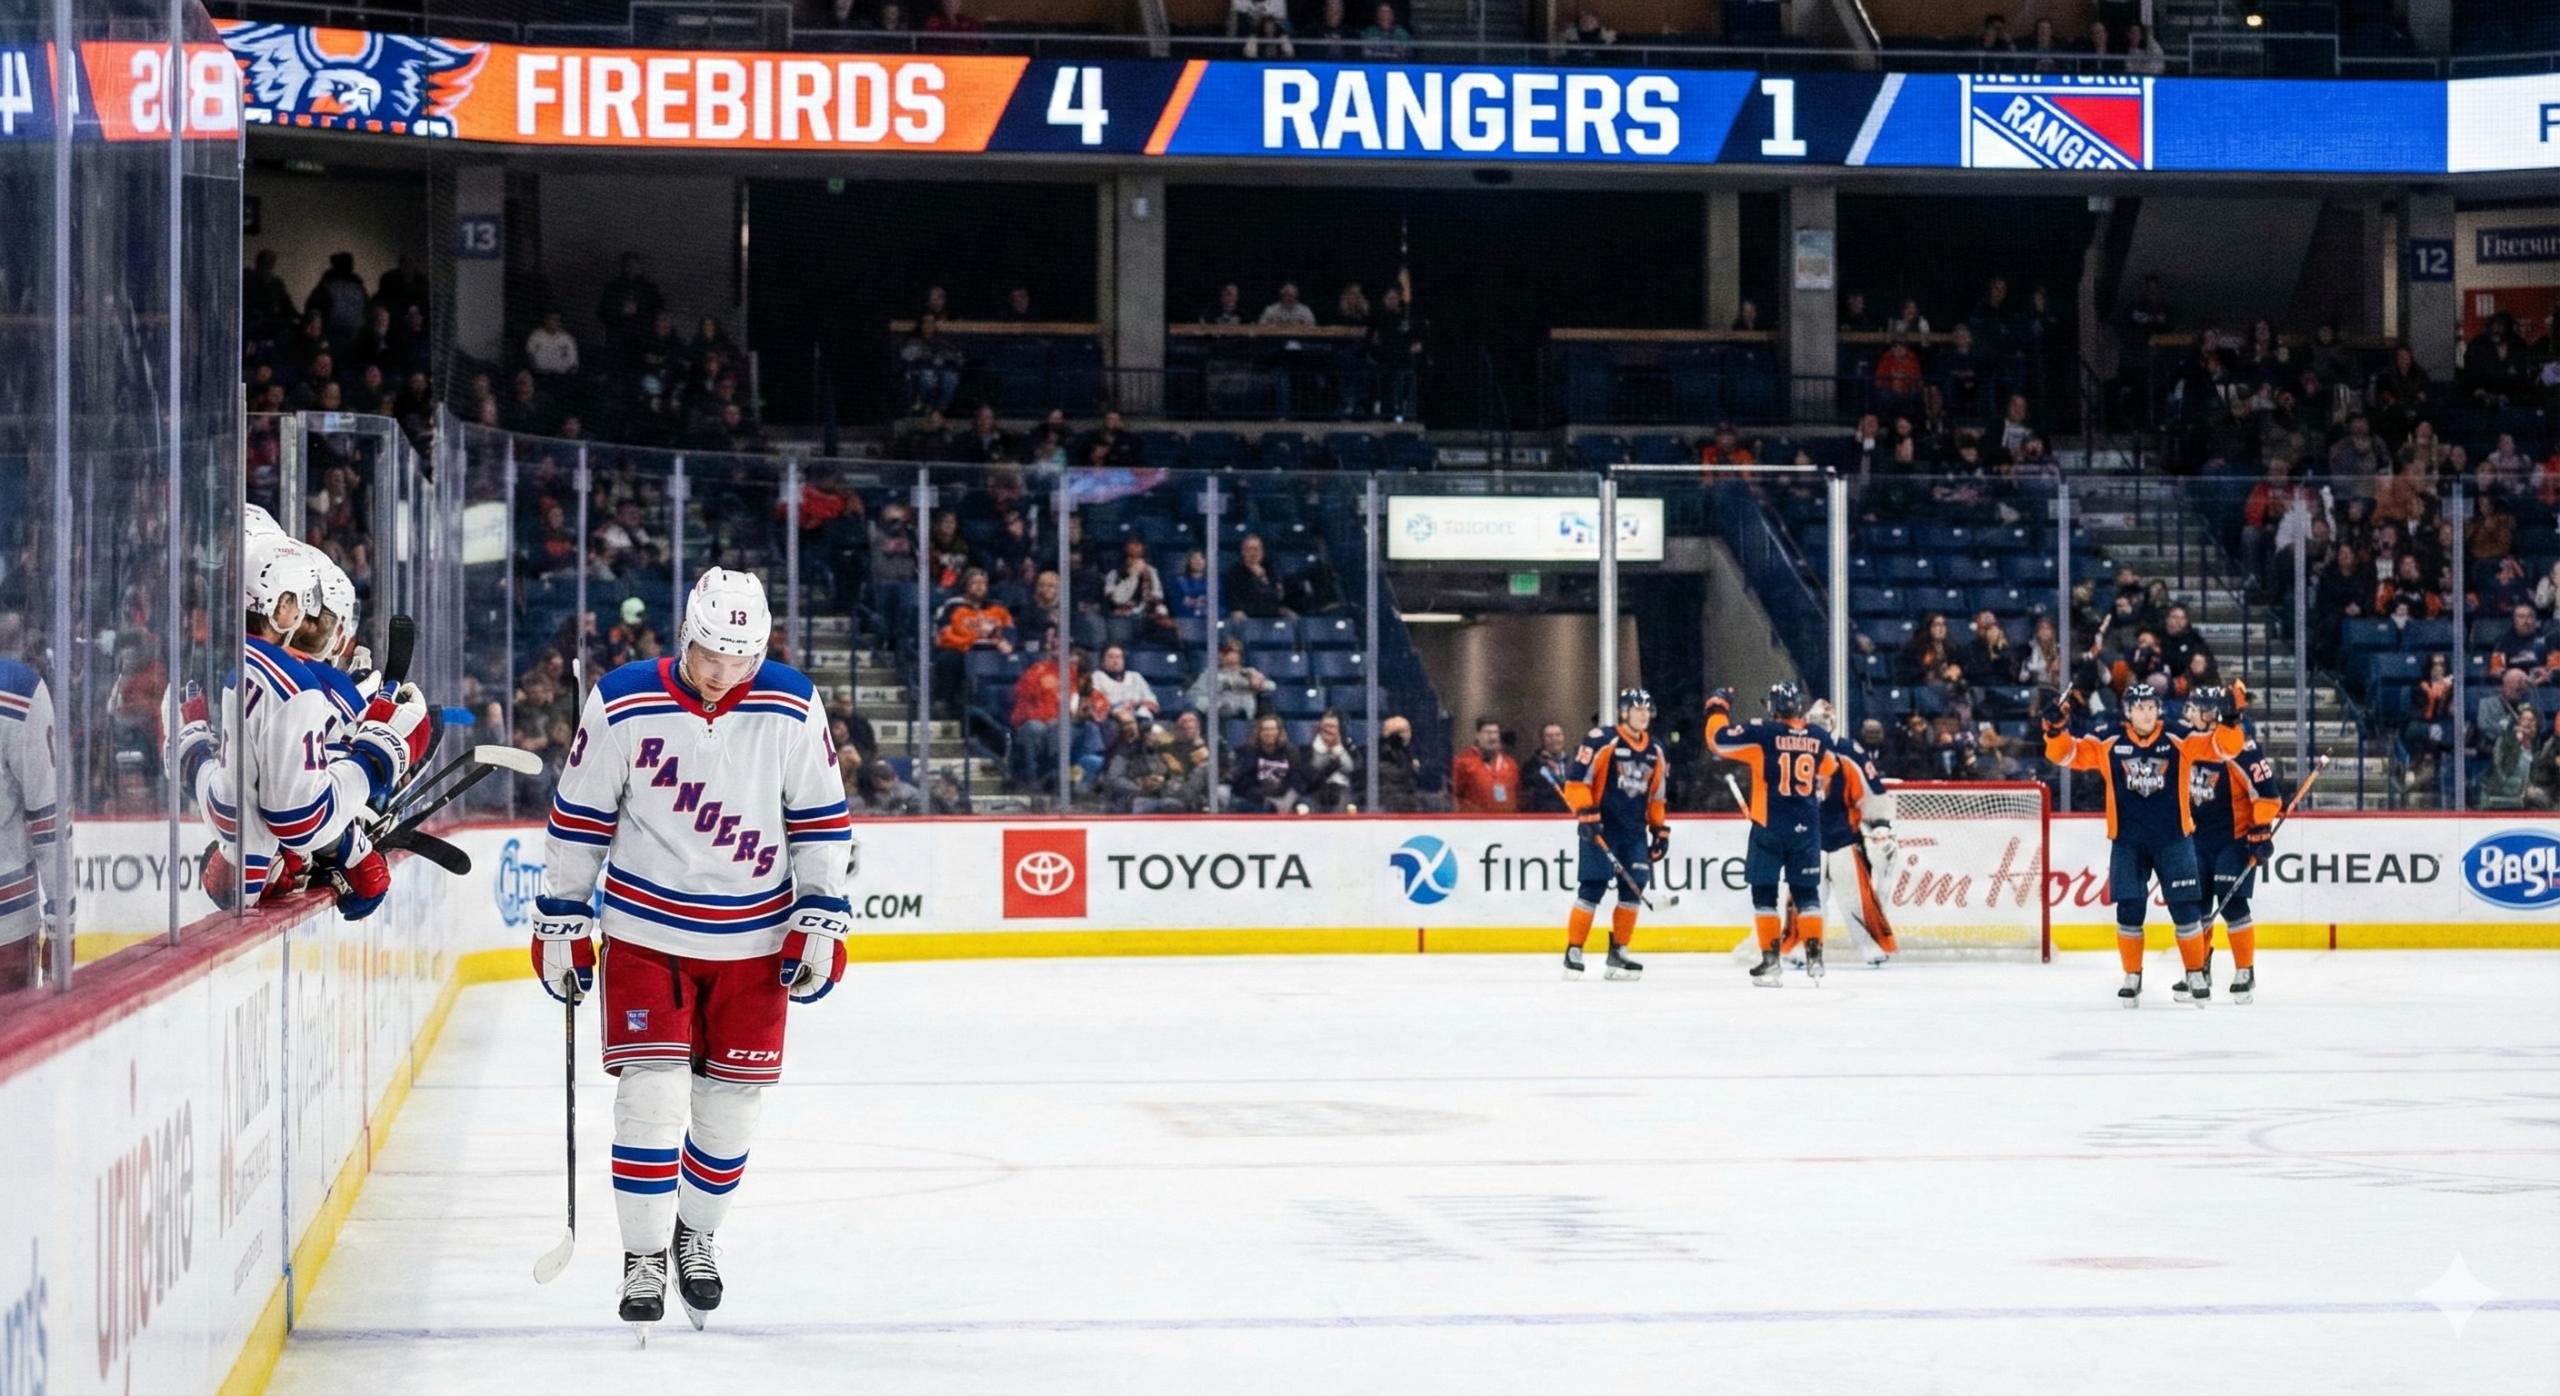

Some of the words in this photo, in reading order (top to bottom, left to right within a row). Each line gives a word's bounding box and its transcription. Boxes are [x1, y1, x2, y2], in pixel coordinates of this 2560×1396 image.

[516, 55, 946, 144] FIREBIRDS
[1046, 66, 1109, 145] 4
[1262, 69, 1680, 156] RANGERS
[1760, 78, 1807, 157] 1
[461, 221, 498, 251] 13
[2415, 247, 2449, 274] 12
[729, 610, 747, 626] 13
[1777, 752, 1816, 797] 19
[2249, 759, 2274, 784] 25
[634, 737, 779, 878] RANGERS
[1107, 853, 1313, 890] TOYOTA
[1479, 844, 1749, 891] finture
[2261, 853, 2441, 884] IGHEAD
[843, 893, 923, 919] .COM
[533, 922, 584, 936] CM
[726, 1048, 781, 1062] CCM
